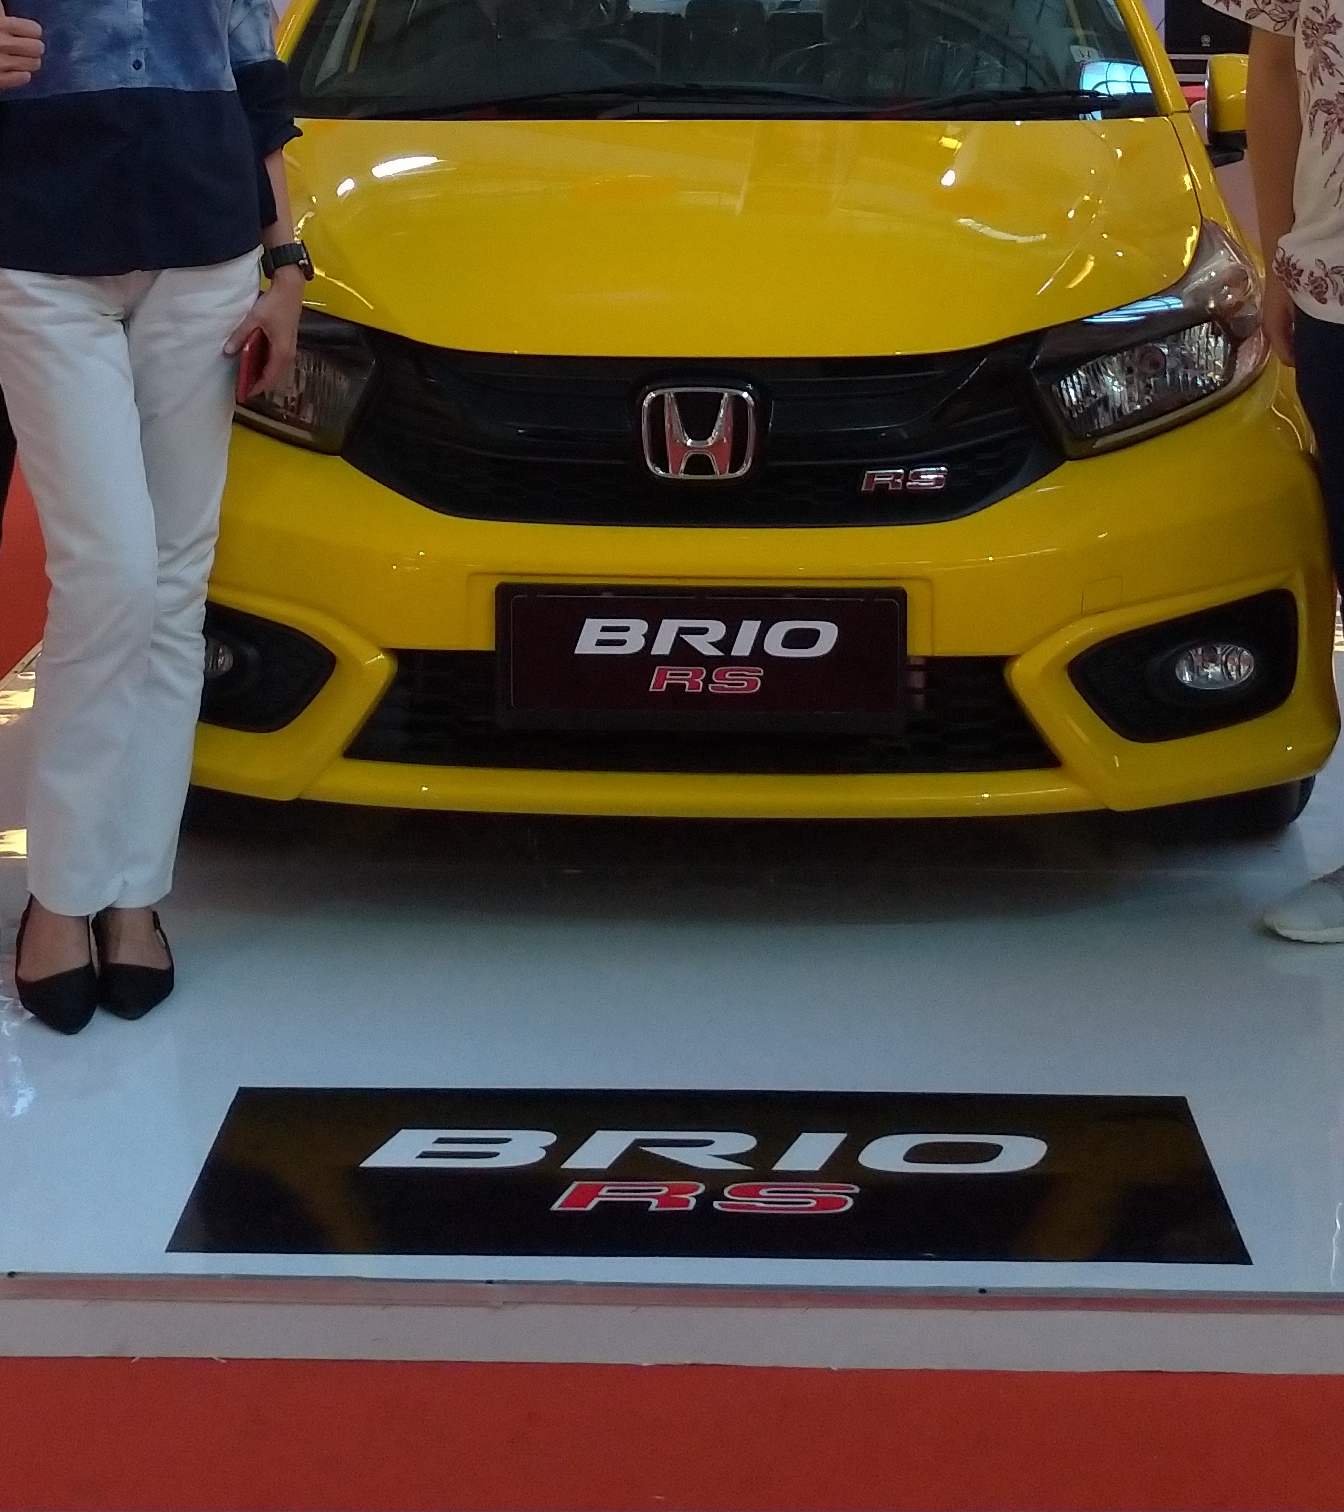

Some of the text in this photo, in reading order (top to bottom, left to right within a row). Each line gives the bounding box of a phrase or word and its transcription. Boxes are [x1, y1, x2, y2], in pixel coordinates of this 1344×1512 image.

[861, 465, 950, 492] RS
[574, 617, 840, 658] BRIO
[648, 666, 765, 694] RS
[357, 1127, 1051, 1175] BRIO
[549, 1179, 862, 1216] RS
